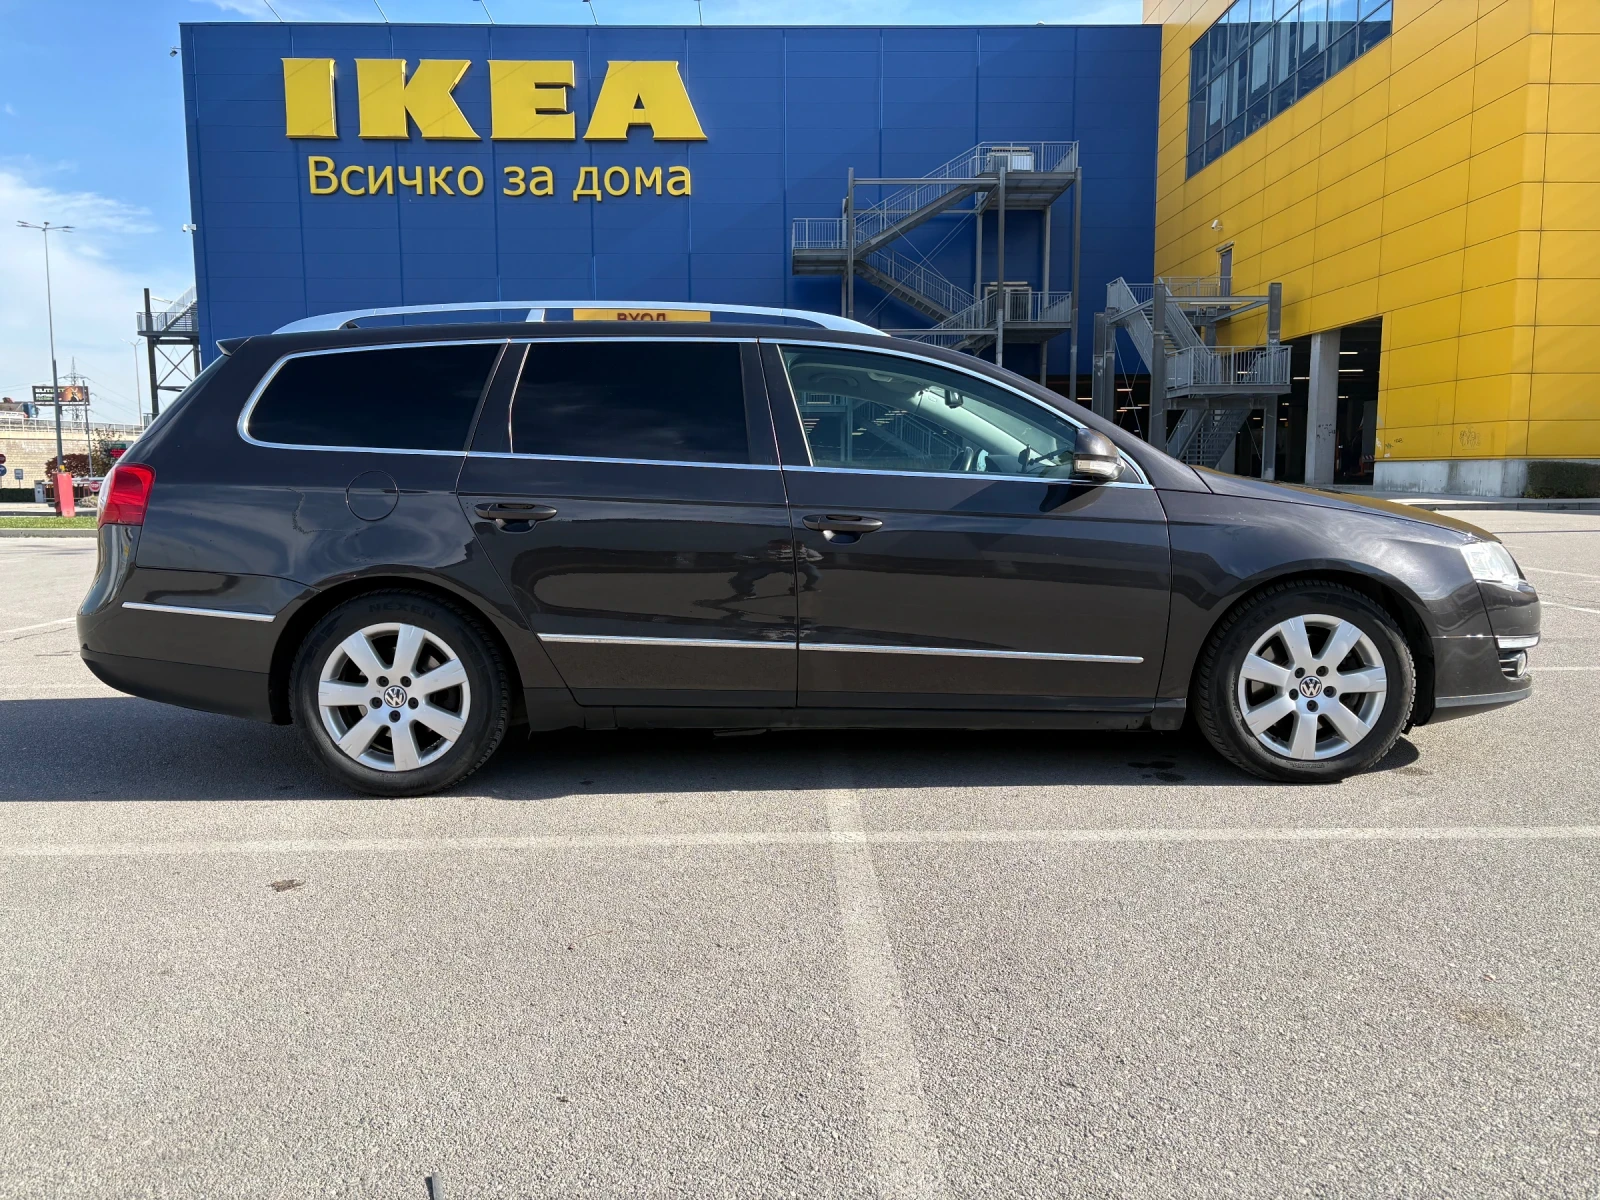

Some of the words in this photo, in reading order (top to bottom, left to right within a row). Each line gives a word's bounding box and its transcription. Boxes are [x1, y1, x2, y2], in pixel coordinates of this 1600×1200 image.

[281, 57, 708, 141] IKEA
[307, 155, 485, 196] Всичко
[502, 165, 555, 196] за
[572, 165, 692, 202] дома
[368, 602, 436, 619] NEXEN
